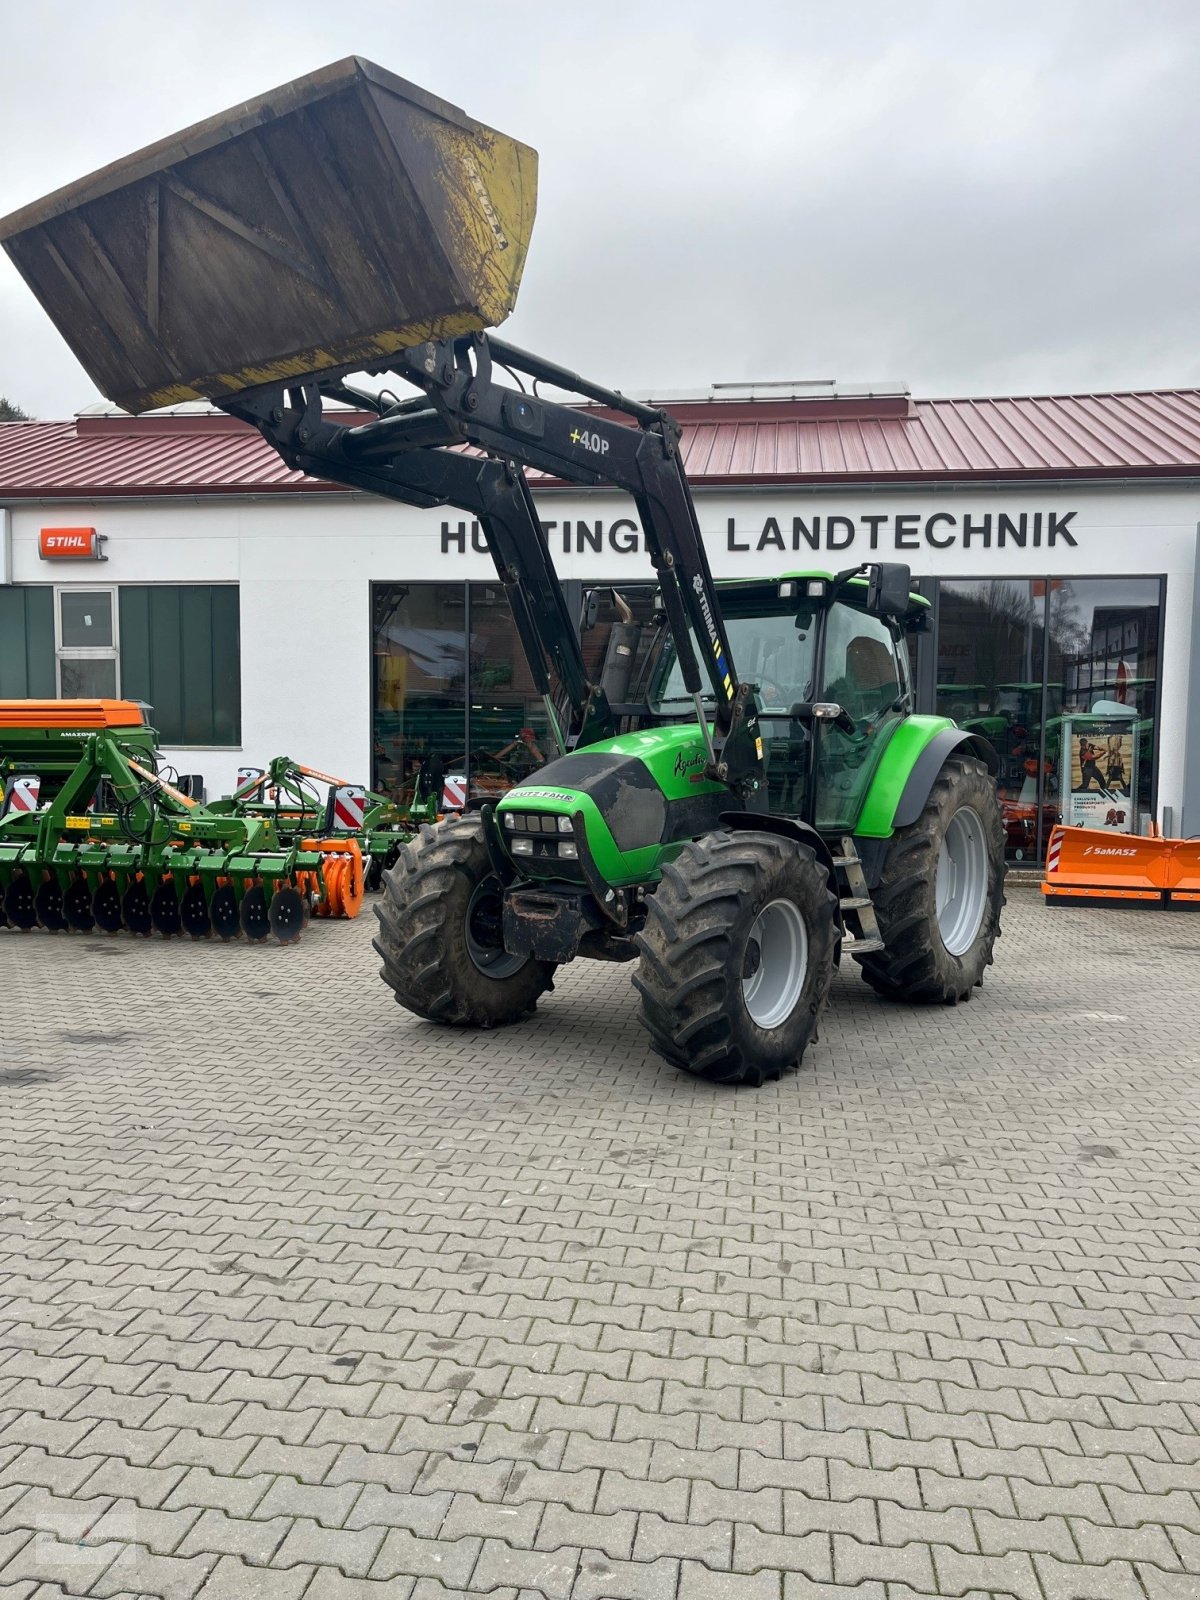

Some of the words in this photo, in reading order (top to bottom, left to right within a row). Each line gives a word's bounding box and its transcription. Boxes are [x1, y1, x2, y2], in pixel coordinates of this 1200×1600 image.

[46, 536, 86, 547] STIHL
[441, 518, 650, 553] HUING
[727, 511, 1079, 551] LANDTECHNIK
[700, 592, 718, 642] TRIMA
[1093, 847, 1138, 856] SaMASZ
